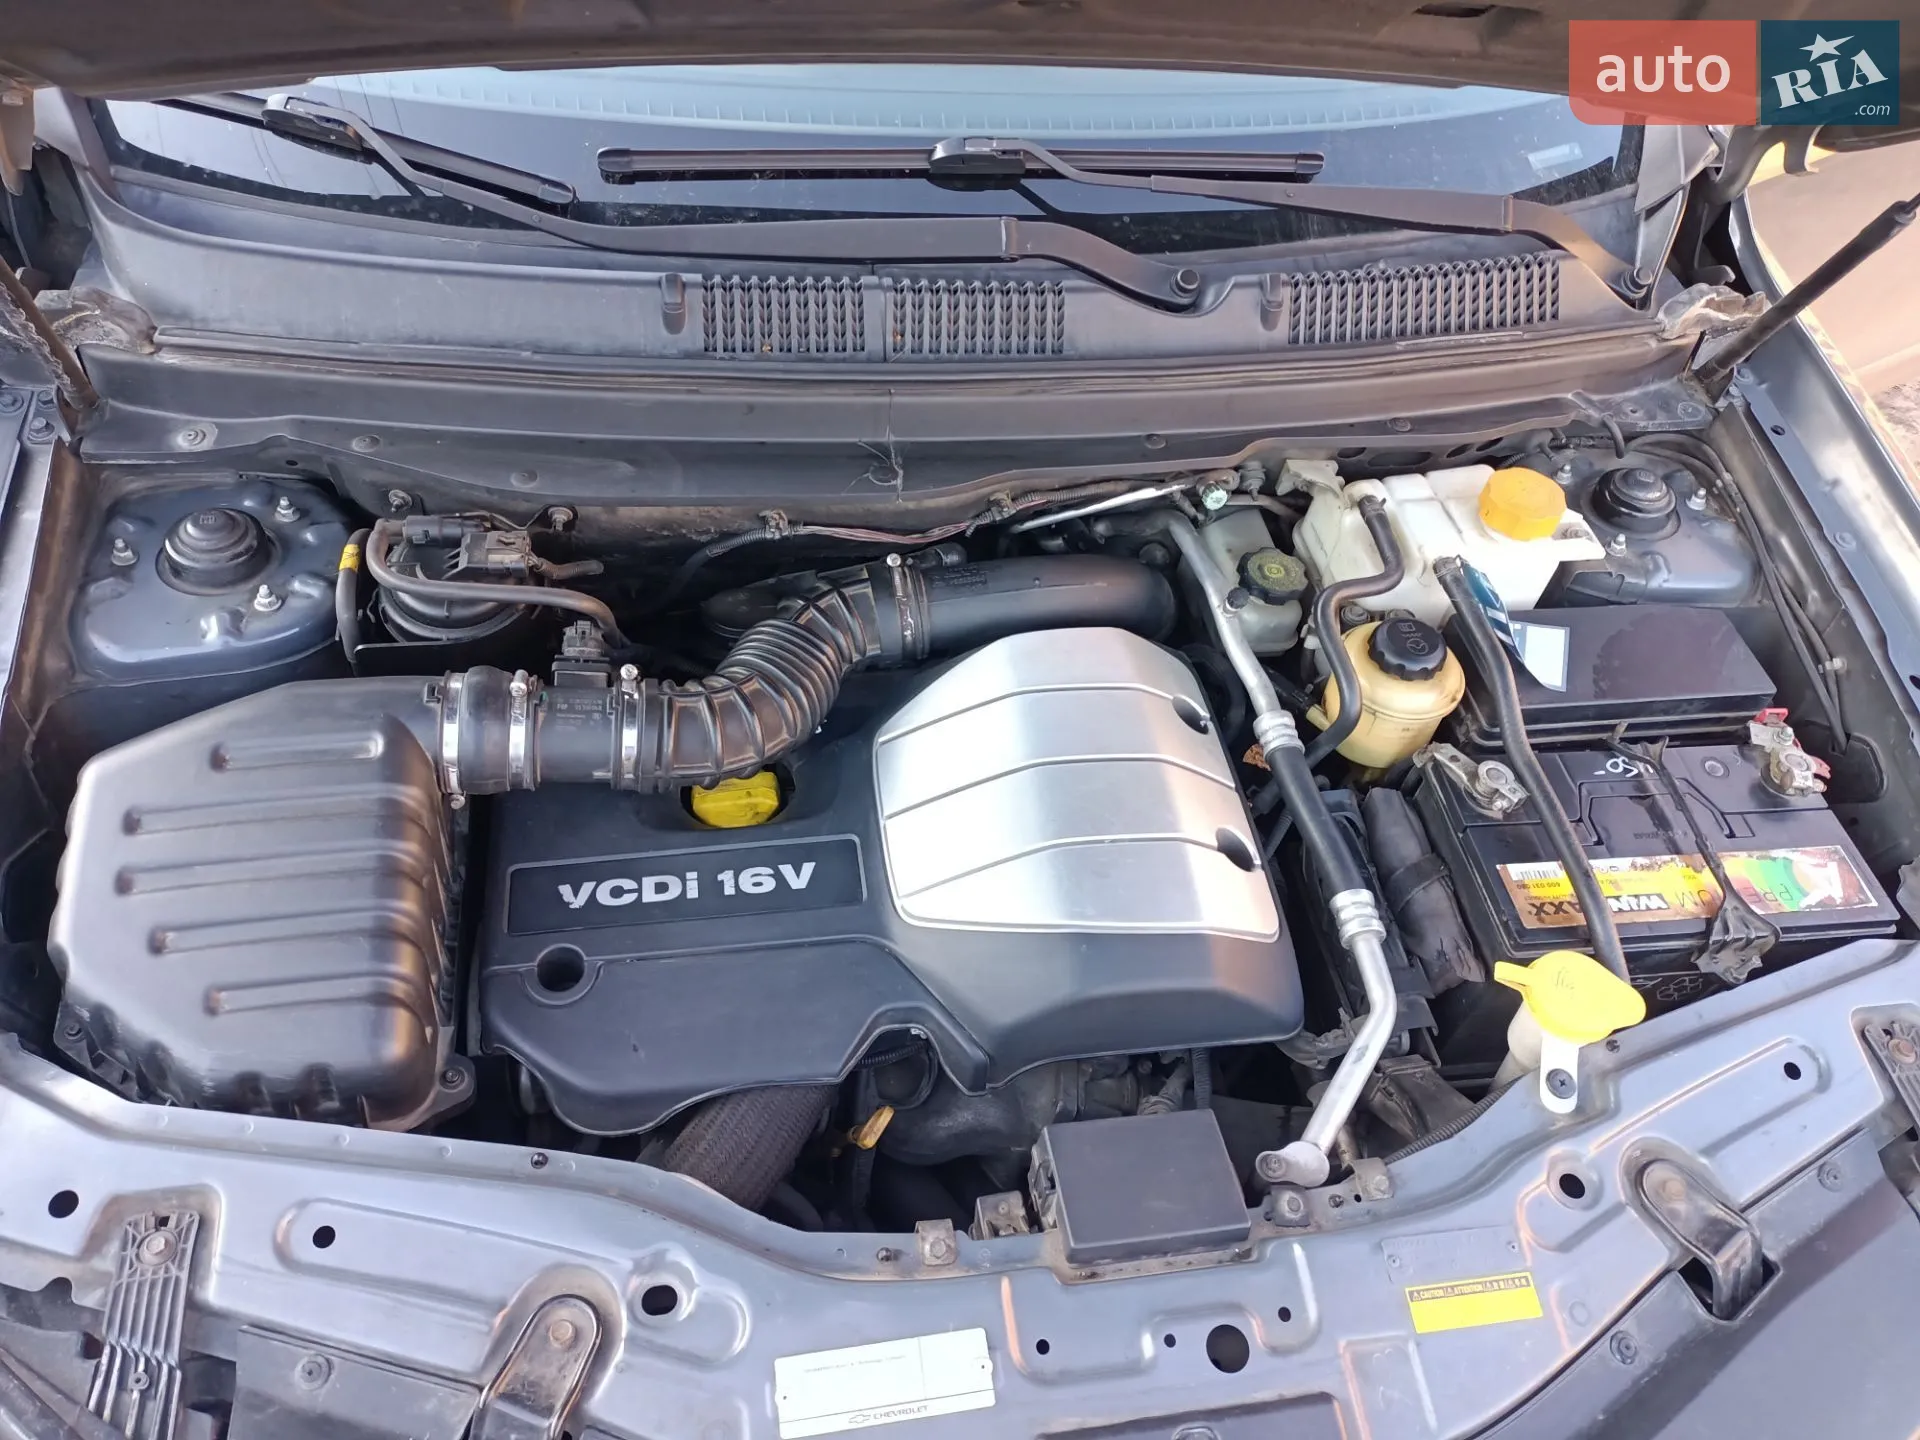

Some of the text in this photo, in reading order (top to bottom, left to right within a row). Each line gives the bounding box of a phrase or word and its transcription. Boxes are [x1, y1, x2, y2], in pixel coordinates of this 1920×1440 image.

[558, 862, 816, 909] VCDi 16V
[873, 1405, 928, 1420] CHEVROLET
